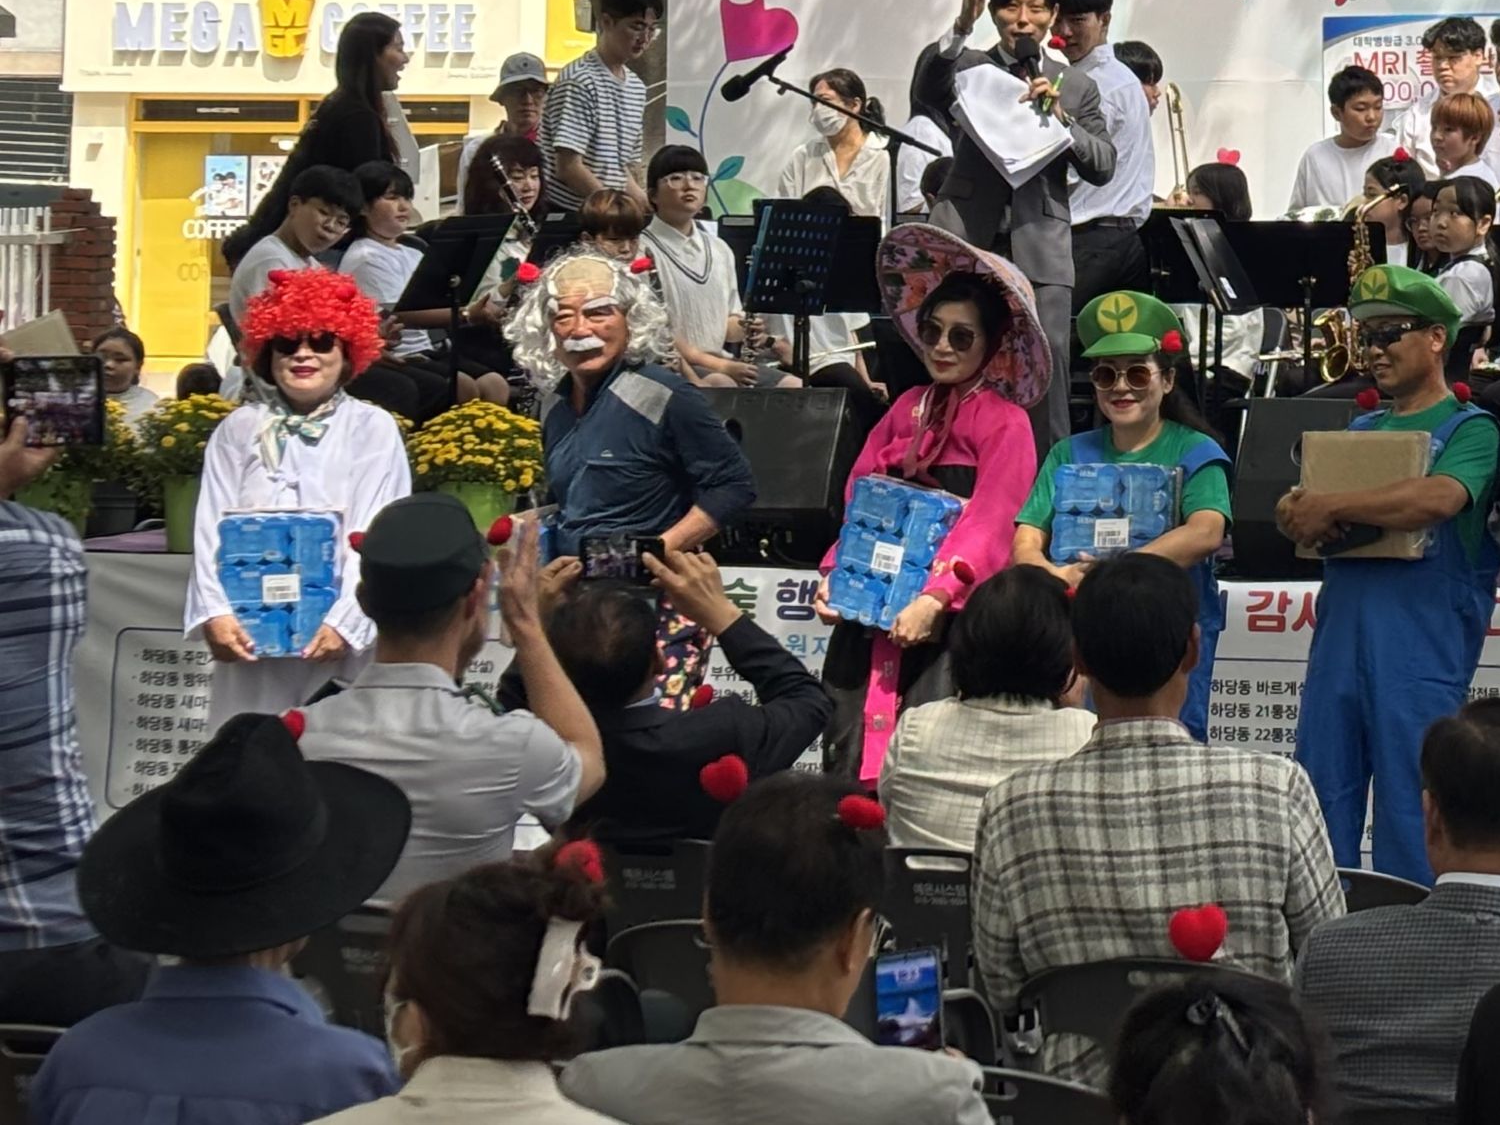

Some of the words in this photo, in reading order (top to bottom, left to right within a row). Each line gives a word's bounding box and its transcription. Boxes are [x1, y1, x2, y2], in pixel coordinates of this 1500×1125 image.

[114, 1, 259, 53] MEGA
[322, 1, 474, 53] CFEE
[1353, 35, 1402, 47] 대학병원급
[1405, 35, 1423, 47] 3.0
[1353, 51, 1408, 75] MRI
[1383, 81, 1436, 103] 00,0
[182, 219, 249, 239] COFFE
[776, 578, 819, 621] 행
[141, 649, 178, 664] 하당동
[182, 650, 213, 666] 주민
[139, 671, 178, 686] 하당동
[183, 673, 213, 687] 방위
[1210, 679, 1251, 695] 하당동
[137, 693, 175, 709] 하당동
[181, 695, 213, 710] 새마
[1210, 703, 1250, 718] 하당동
[136, 716, 173, 731] 하당동
[178, 717, 208, 732] 새마
[1209, 726, 1249, 742] 하당동
[136, 739, 172, 753] 하당동
[134, 761, 168, 776] 하당동
